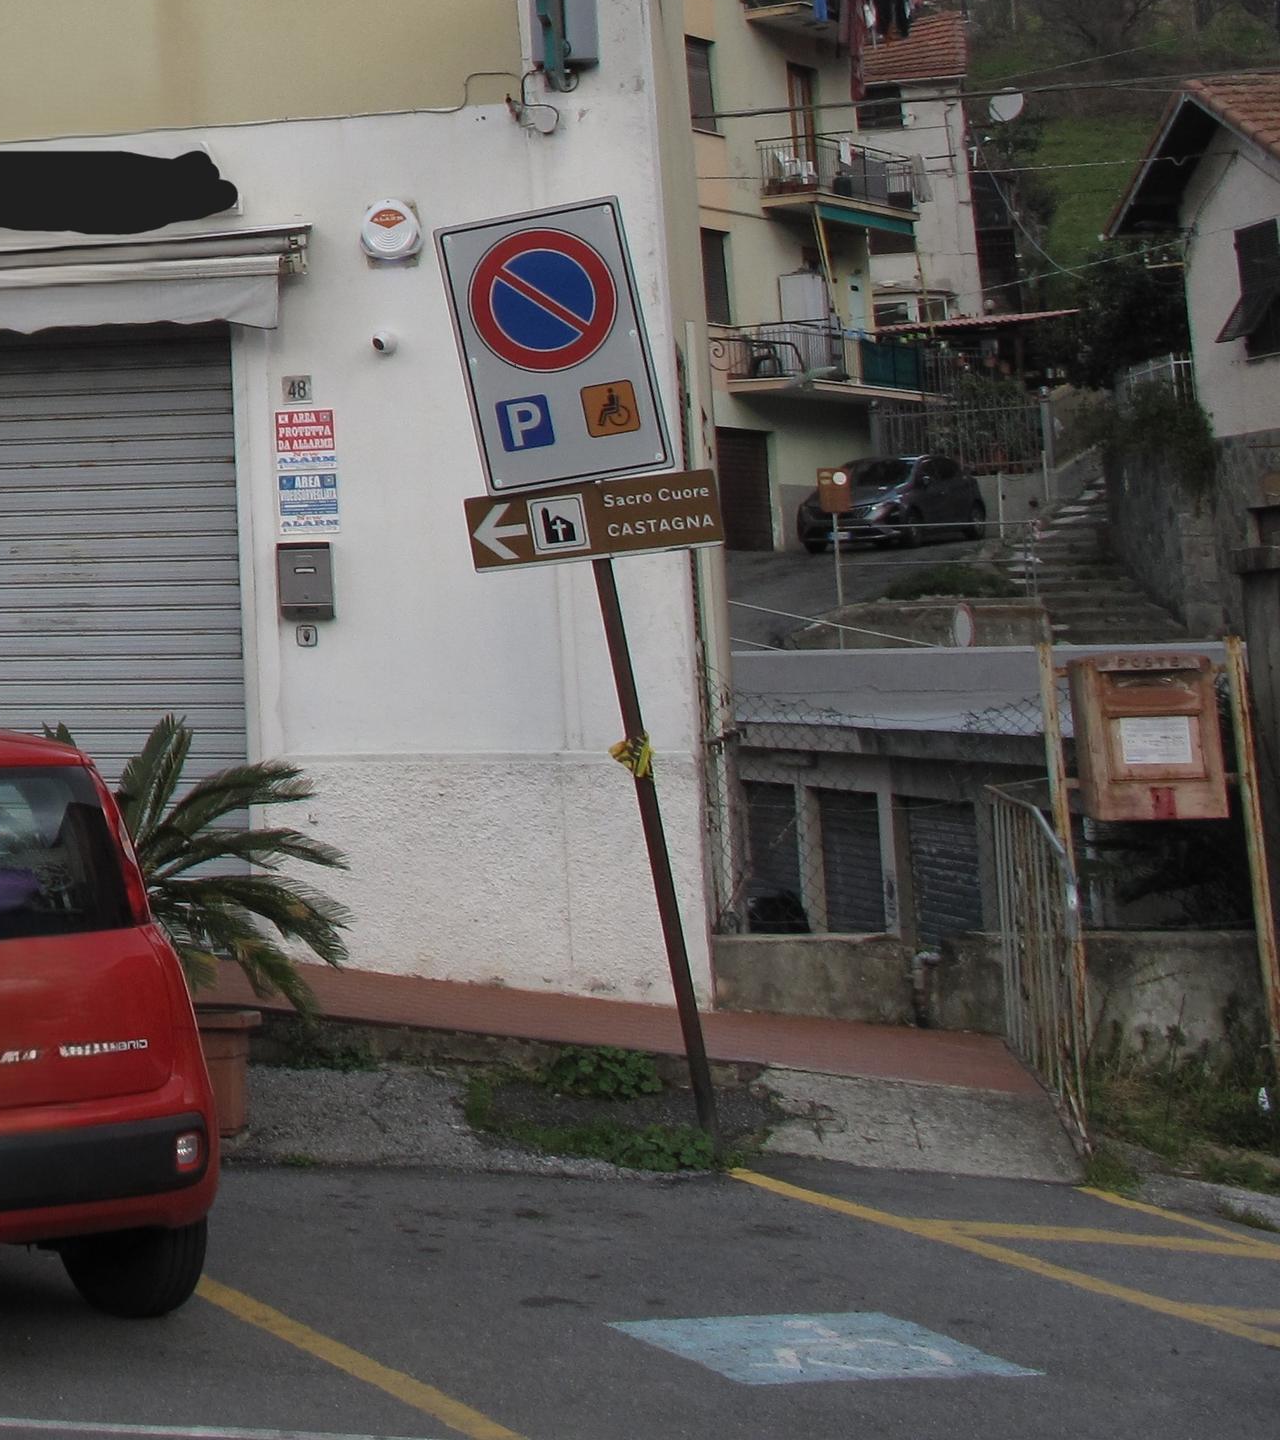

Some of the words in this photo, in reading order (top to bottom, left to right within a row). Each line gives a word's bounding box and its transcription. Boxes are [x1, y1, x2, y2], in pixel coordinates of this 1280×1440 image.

[288, 380, 307, 399] 48
[292, 412, 317, 424] AREA
[506, 401, 542, 447] P
[278, 425, 332, 438] PROTETTA
[278, 439, 291, 451] DA
[292, 438, 334, 450] ALLARME
[294, 475, 321, 489] AREA
[603, 492, 653, 508] Sacro
[657, 486, 710, 502] Cuore
[607, 514, 715, 537] CASTAGNA
